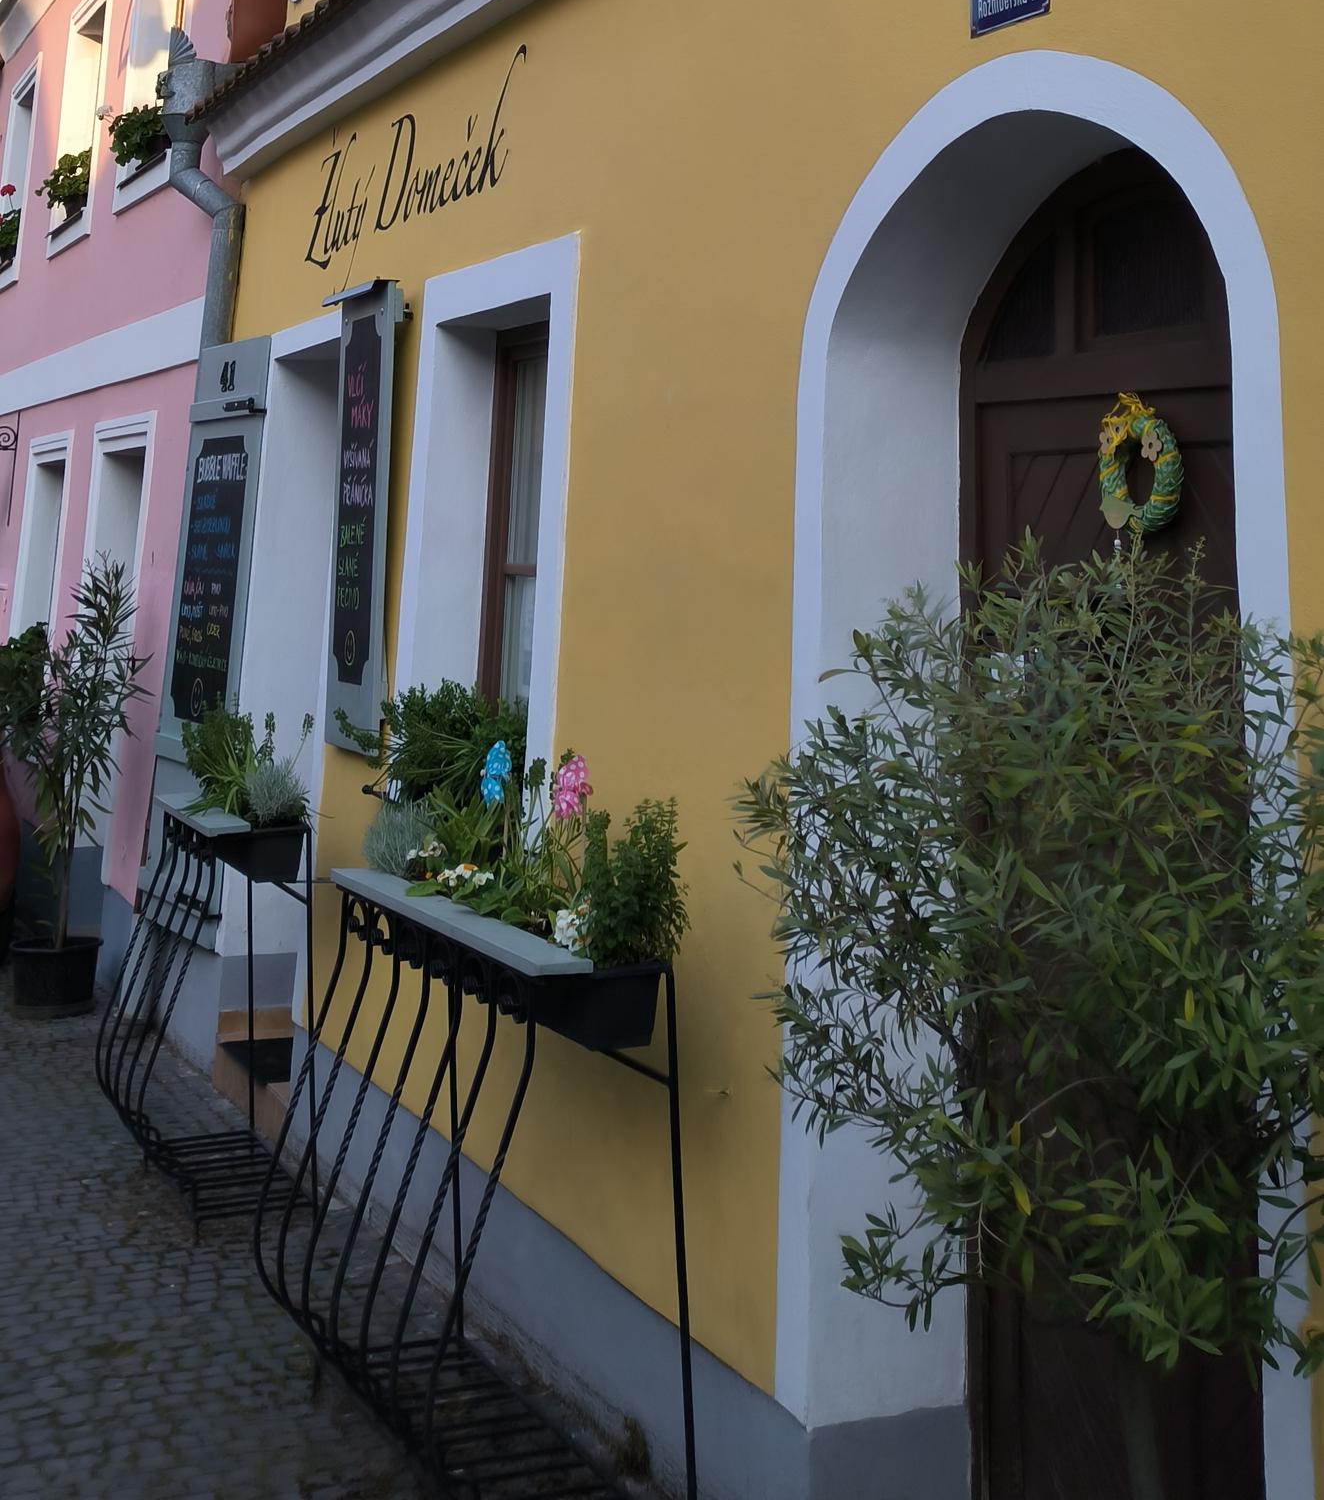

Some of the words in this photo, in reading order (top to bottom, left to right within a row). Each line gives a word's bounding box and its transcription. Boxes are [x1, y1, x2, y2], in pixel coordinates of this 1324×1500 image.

[304, 126, 376, 295] Žlutý
[373, 43, 527, 234] Domeček
[219, 360, 237, 393] 41
[196, 454, 222, 484] BUBBLE
